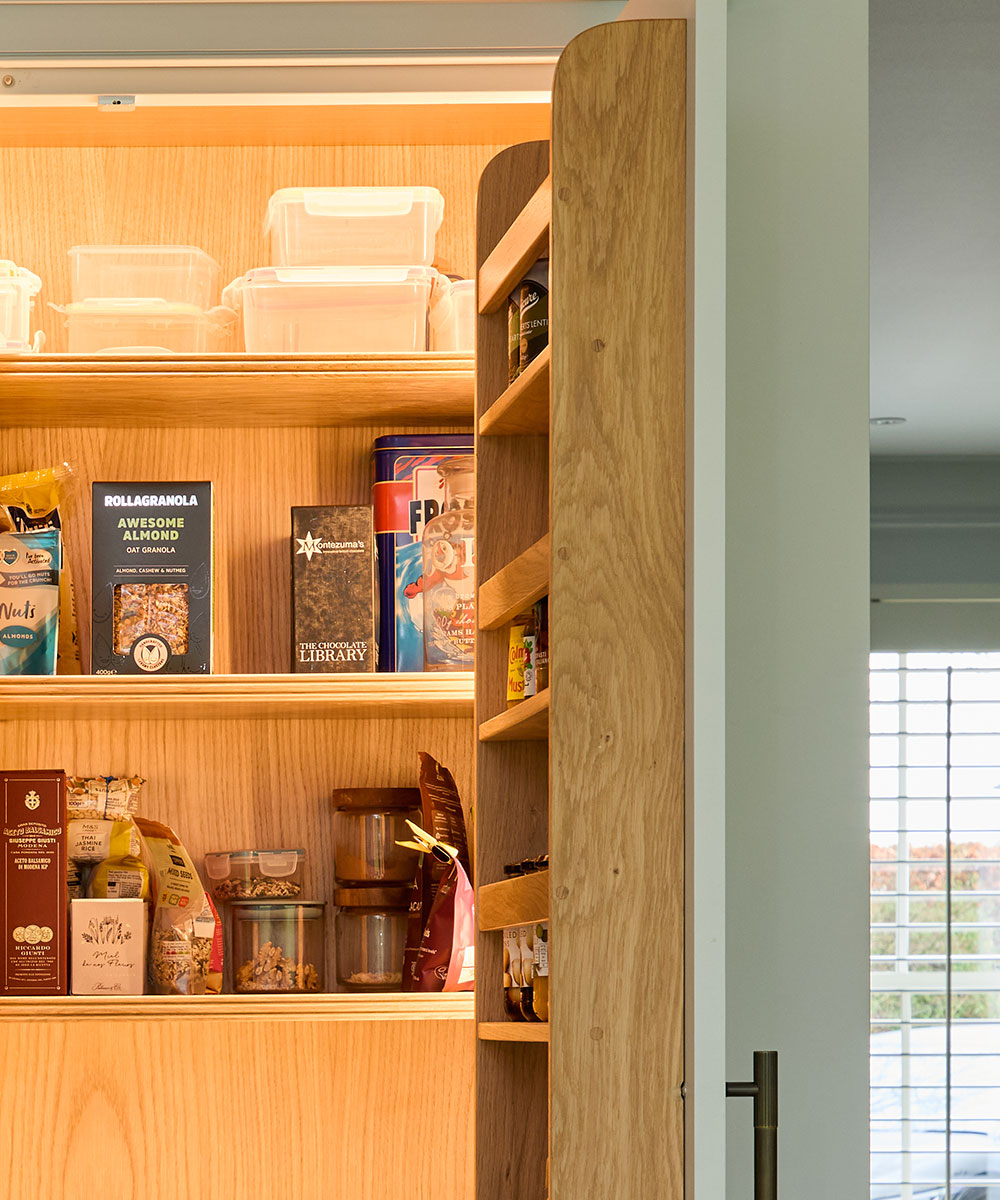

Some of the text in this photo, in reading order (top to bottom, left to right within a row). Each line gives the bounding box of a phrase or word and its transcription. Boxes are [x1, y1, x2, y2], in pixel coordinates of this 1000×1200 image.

[104, 495, 198, 507] ROLLAGRANOLA
[117, 518, 185, 528] AWESOME
[122, 530, 180, 541] ALMOND
[303, 540, 365, 551] Montezuma's
[300, 641, 367, 650] THE CHOCOLATE
[300, 649, 367, 662] LIBRARY
